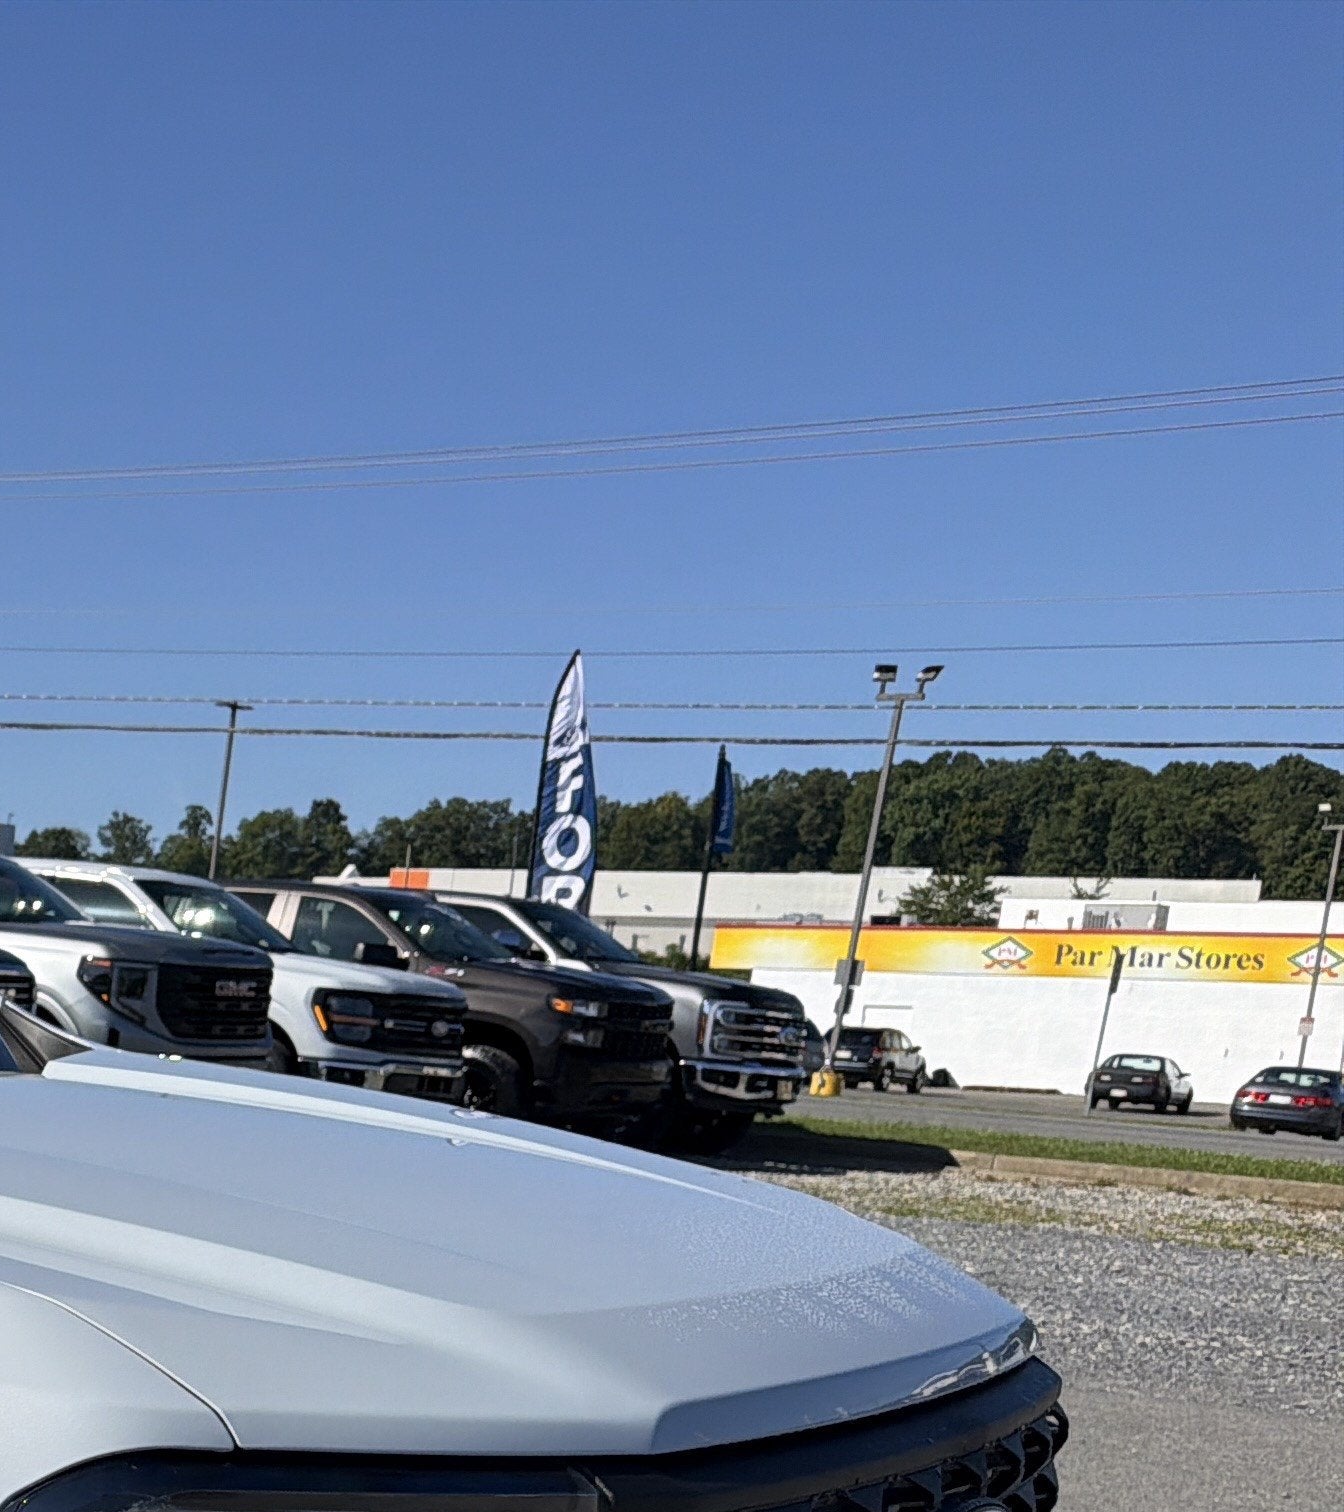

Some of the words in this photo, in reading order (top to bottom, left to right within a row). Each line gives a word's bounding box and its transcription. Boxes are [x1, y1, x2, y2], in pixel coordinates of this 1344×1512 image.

[1054, 943, 1103, 967] Par
[1108, 945, 1172, 969] Mar
[1175, 943, 1265, 971] Stores
[215, 980, 258, 997] GMC
